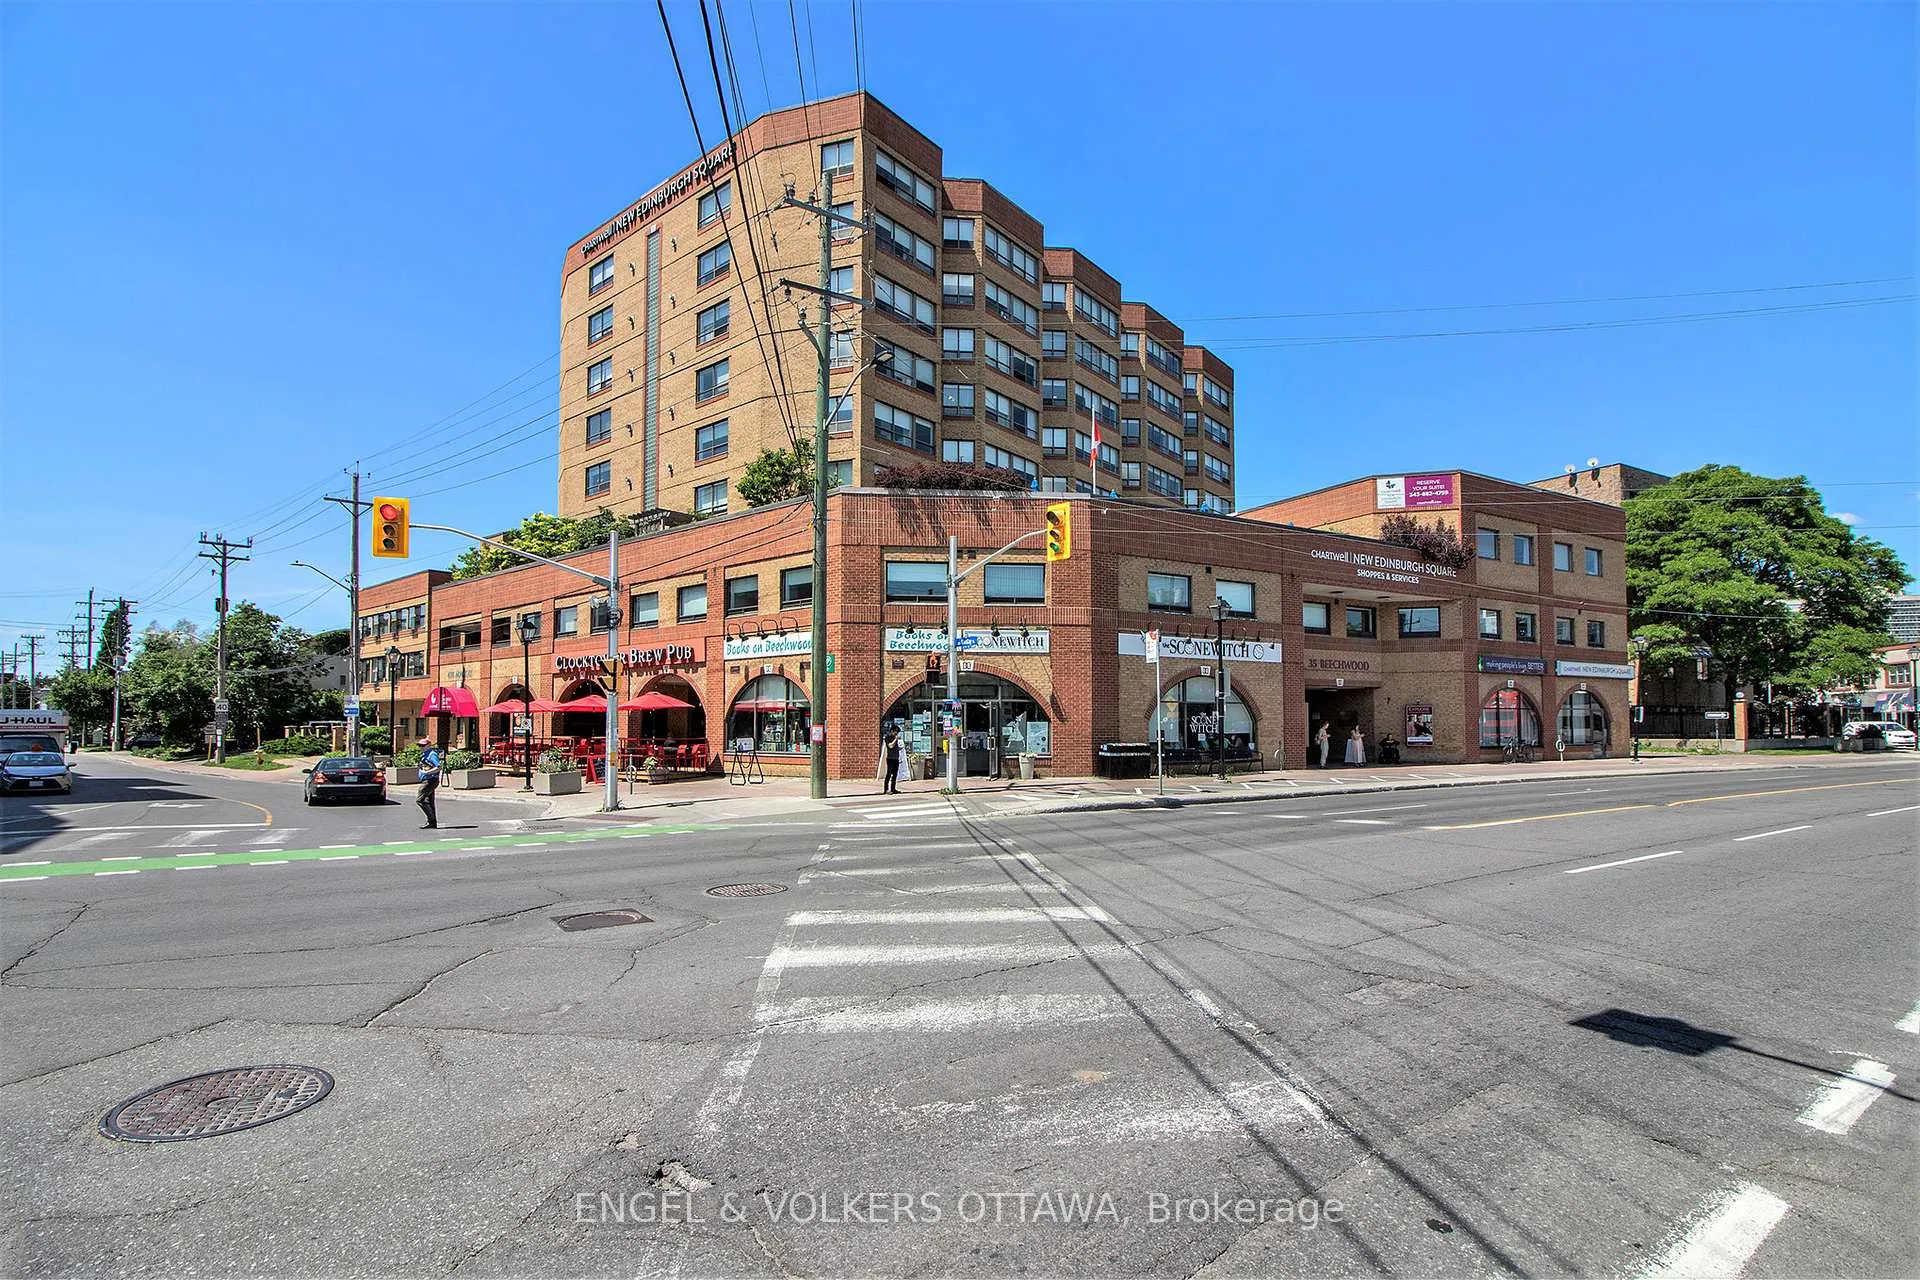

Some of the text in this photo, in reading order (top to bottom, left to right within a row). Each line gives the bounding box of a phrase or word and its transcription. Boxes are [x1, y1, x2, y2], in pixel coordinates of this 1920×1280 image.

[616, 209, 636, 231] NEW
[636, 172, 691, 217] EDINBURGH
[1353, 553, 1373, 565] NEW
[1375, 556, 1424, 573] EDINBURGH
[1425, 563, 1457, 577] SQUARE
[1357, 569, 1385, 580] SHOPPES
[1391, 574, 1419, 584] SERVICES
[896, 630, 932, 640] Books
[629, 647, 663, 664] BREW
[667, 644, 692, 659] PUB
[727, 643, 749, 655] Books
[753, 644, 762, 653] on
[1308, 659, 1370, 671] 35 BEECHWOOD
[1190, 724, 1219, 733] WITCH
